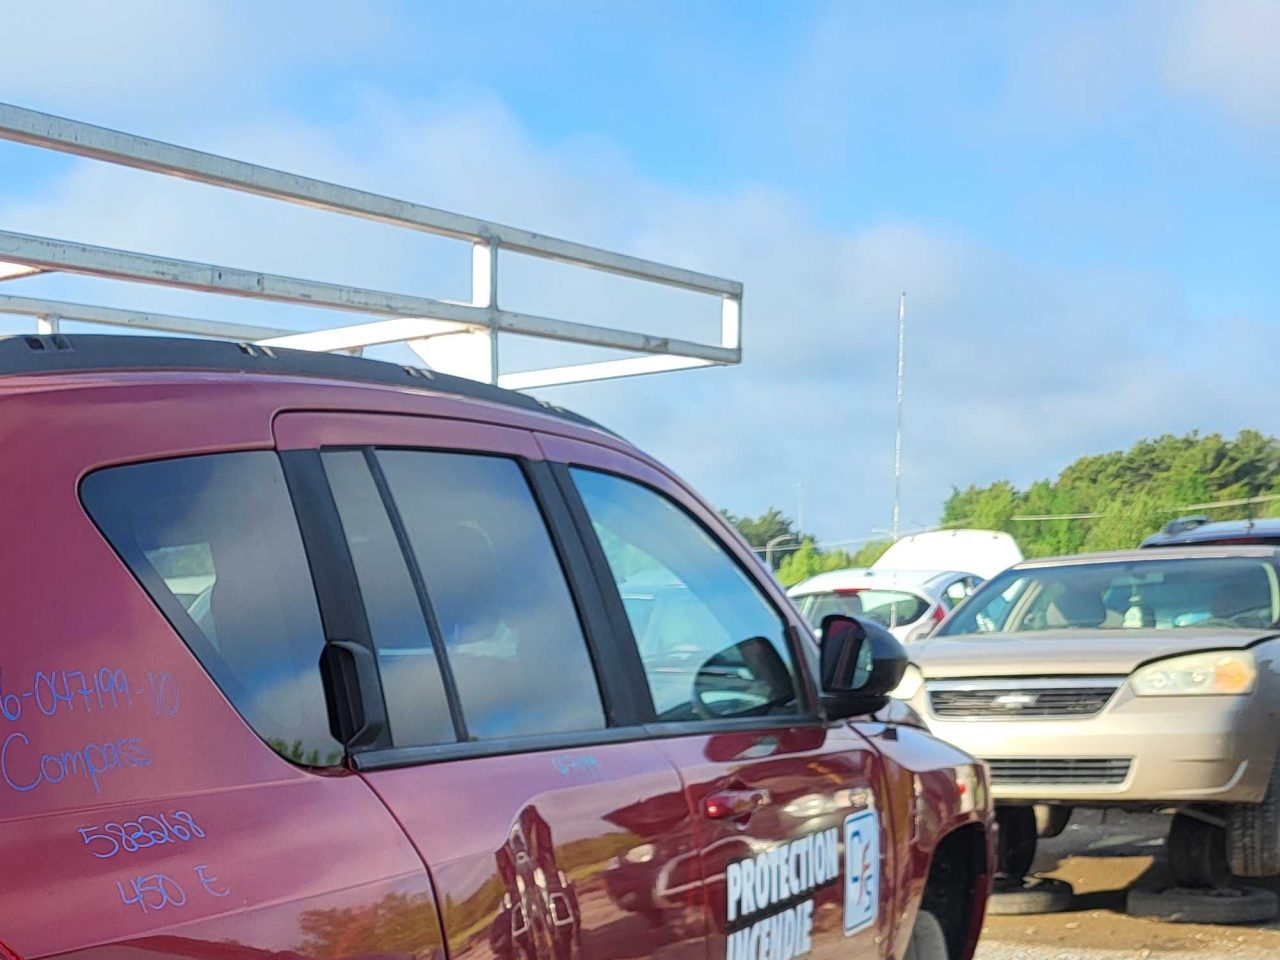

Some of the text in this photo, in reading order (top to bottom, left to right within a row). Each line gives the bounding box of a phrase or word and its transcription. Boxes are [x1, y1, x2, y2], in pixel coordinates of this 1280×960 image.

[1, 732, 152, 792] Compass
[117, 874, 186, 914] 450
[726, 826, 840, 922] PROTECTION
